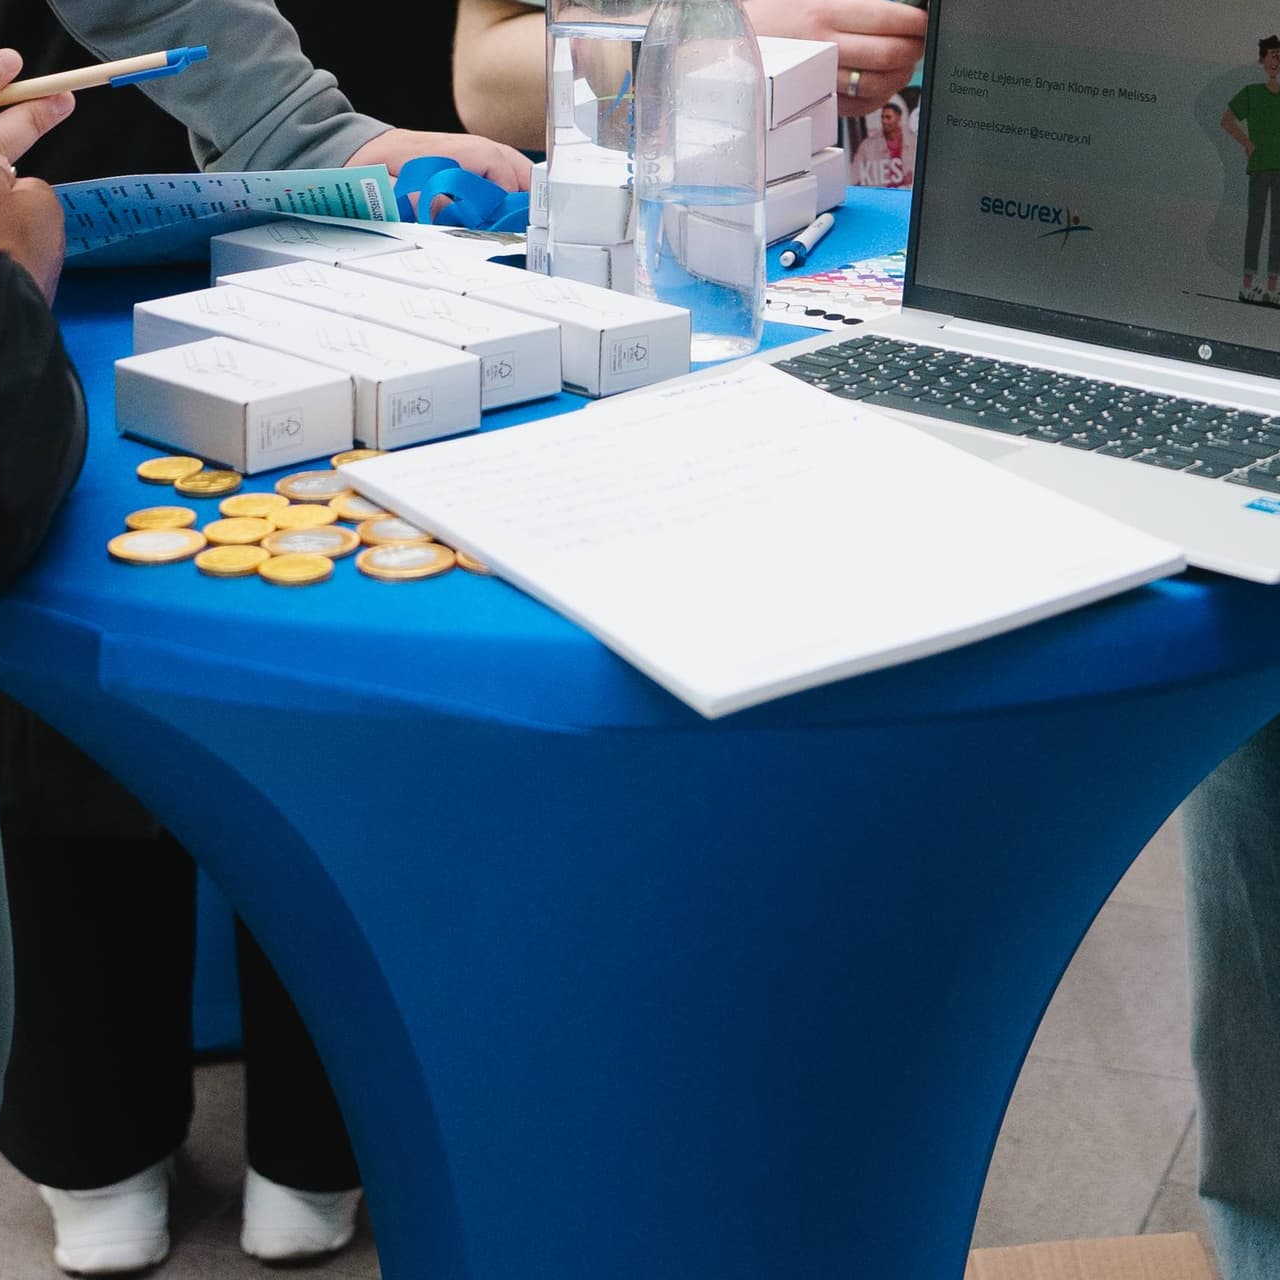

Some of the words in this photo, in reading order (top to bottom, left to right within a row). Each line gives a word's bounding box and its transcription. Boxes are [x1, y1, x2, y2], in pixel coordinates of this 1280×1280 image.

[949, 82, 989, 98] Daemen
[950, 65, 989, 82] Juliette
[1035, 76, 1065, 92] Bryan
[1068, 81, 1099, 97] Klomp
[1102, 87, 1115, 97] en
[1118, 87, 1157, 103] Melissa
[859, 157, 904, 186] KIES
[980, 196, 1063, 225] securex
